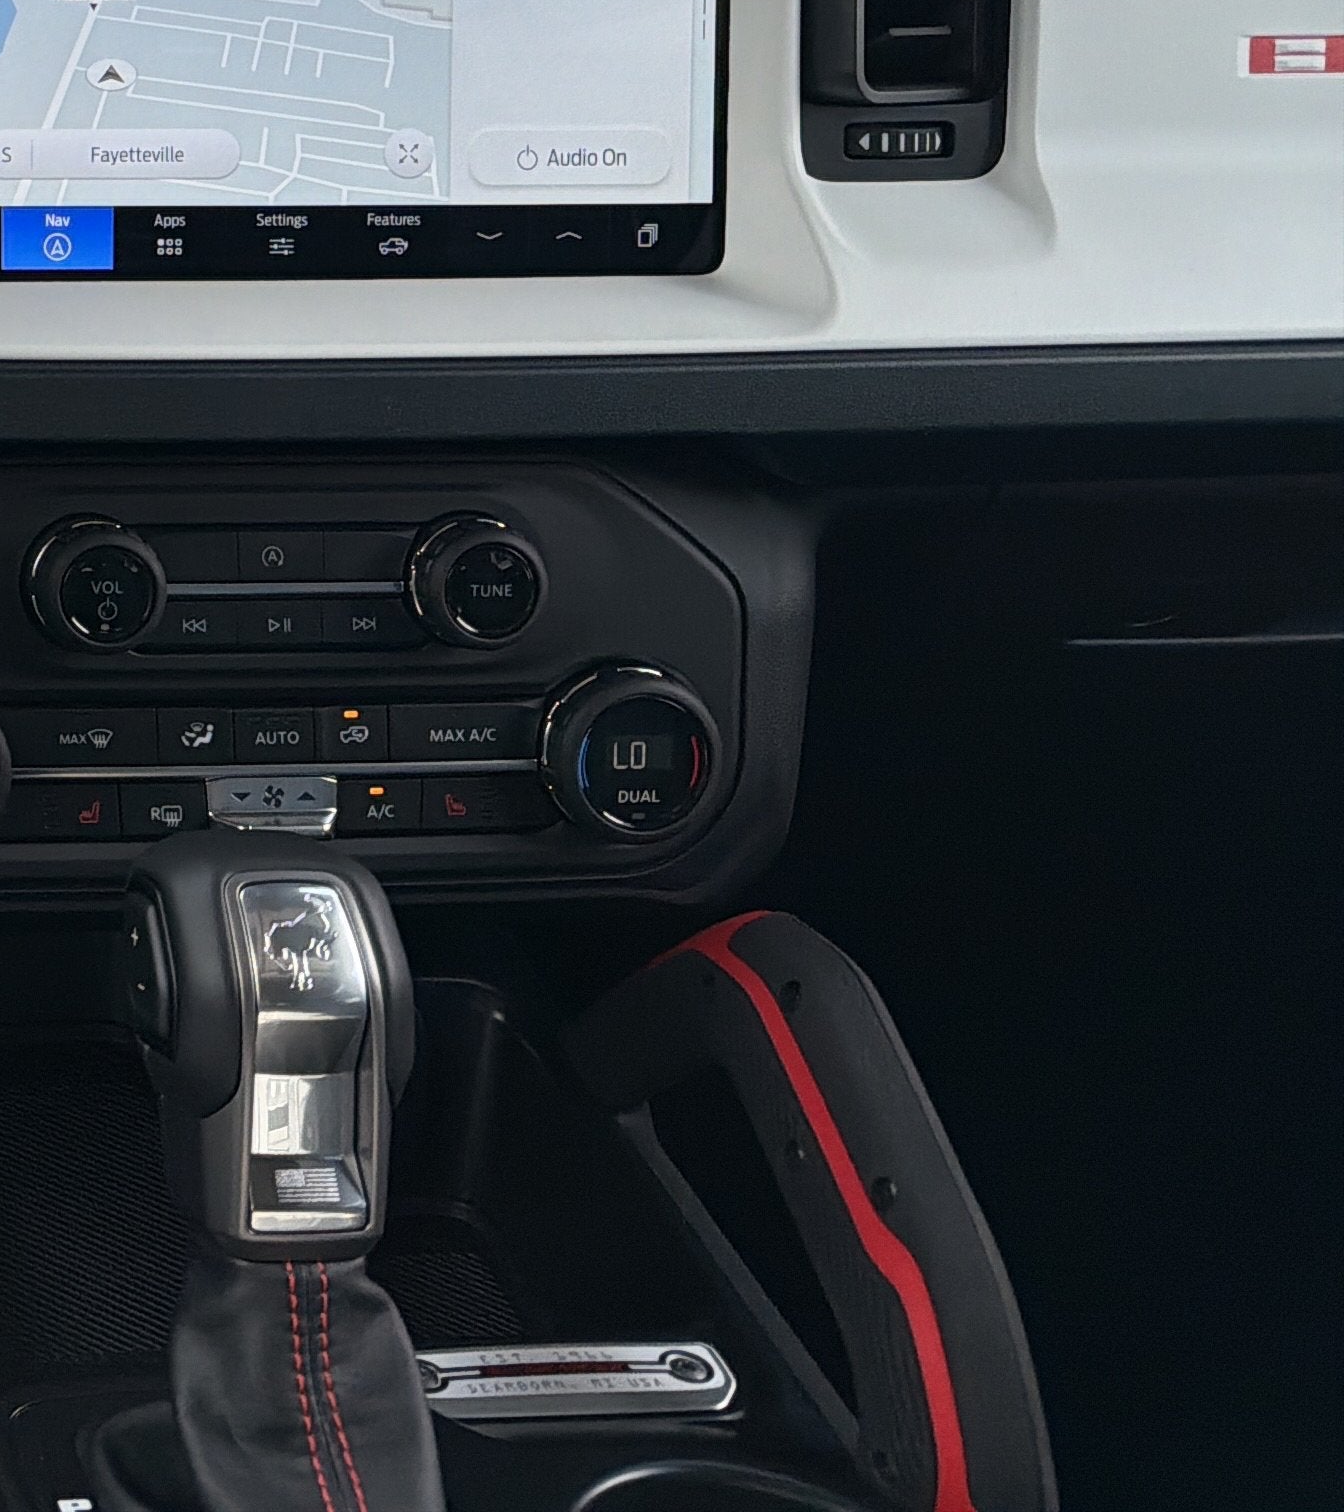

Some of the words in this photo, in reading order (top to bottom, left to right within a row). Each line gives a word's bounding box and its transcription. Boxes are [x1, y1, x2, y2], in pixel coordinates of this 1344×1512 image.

[1, 146, 13, 163] S
[90, 146, 185, 167] Fayetteville
[546, 147, 599, 169] Audio
[602, 147, 628, 169] On
[44, 213, 71, 228] Nav
[154, 213, 186, 230] Apps
[255, 212, 309, 230] Settings
[366, 211, 422, 228] Features
[91, 581, 124, 595] VOL
[470, 583, 513, 598] TUNE
[58, 732, 88, 746] MAX
[254, 731, 300, 746] AUTO
[429, 728, 465, 743] MAX
[469, 727, 498, 743] A/C
[612, 740, 647, 771] LO
[617, 789, 661, 804] DUAL
[366, 804, 396, 820] A/C
